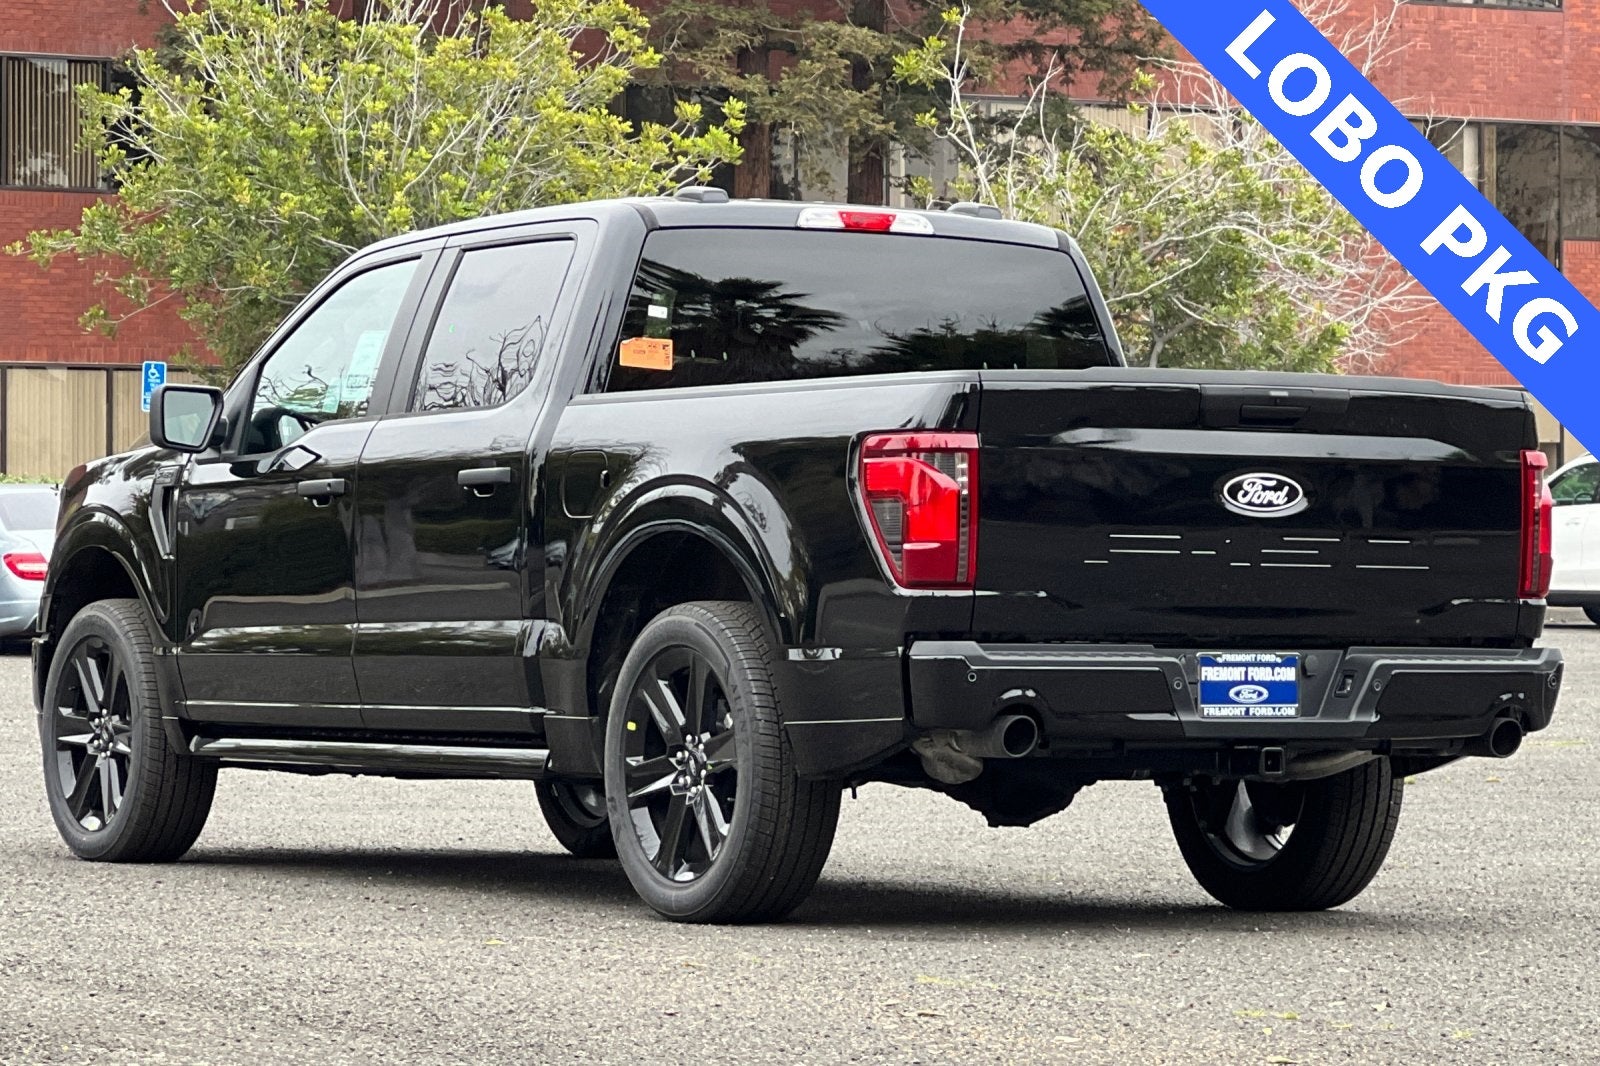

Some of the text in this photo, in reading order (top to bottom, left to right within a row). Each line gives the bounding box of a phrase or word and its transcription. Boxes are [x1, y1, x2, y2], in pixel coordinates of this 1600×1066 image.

[1237, 478, 1289, 505] Ford
[1222, 653, 1277, 662] FREMONT FORD
[1201, 667, 1296, 681] FREMONT FORD.COM
[1203, 707, 1296, 716] FREMONT FORD.COM
